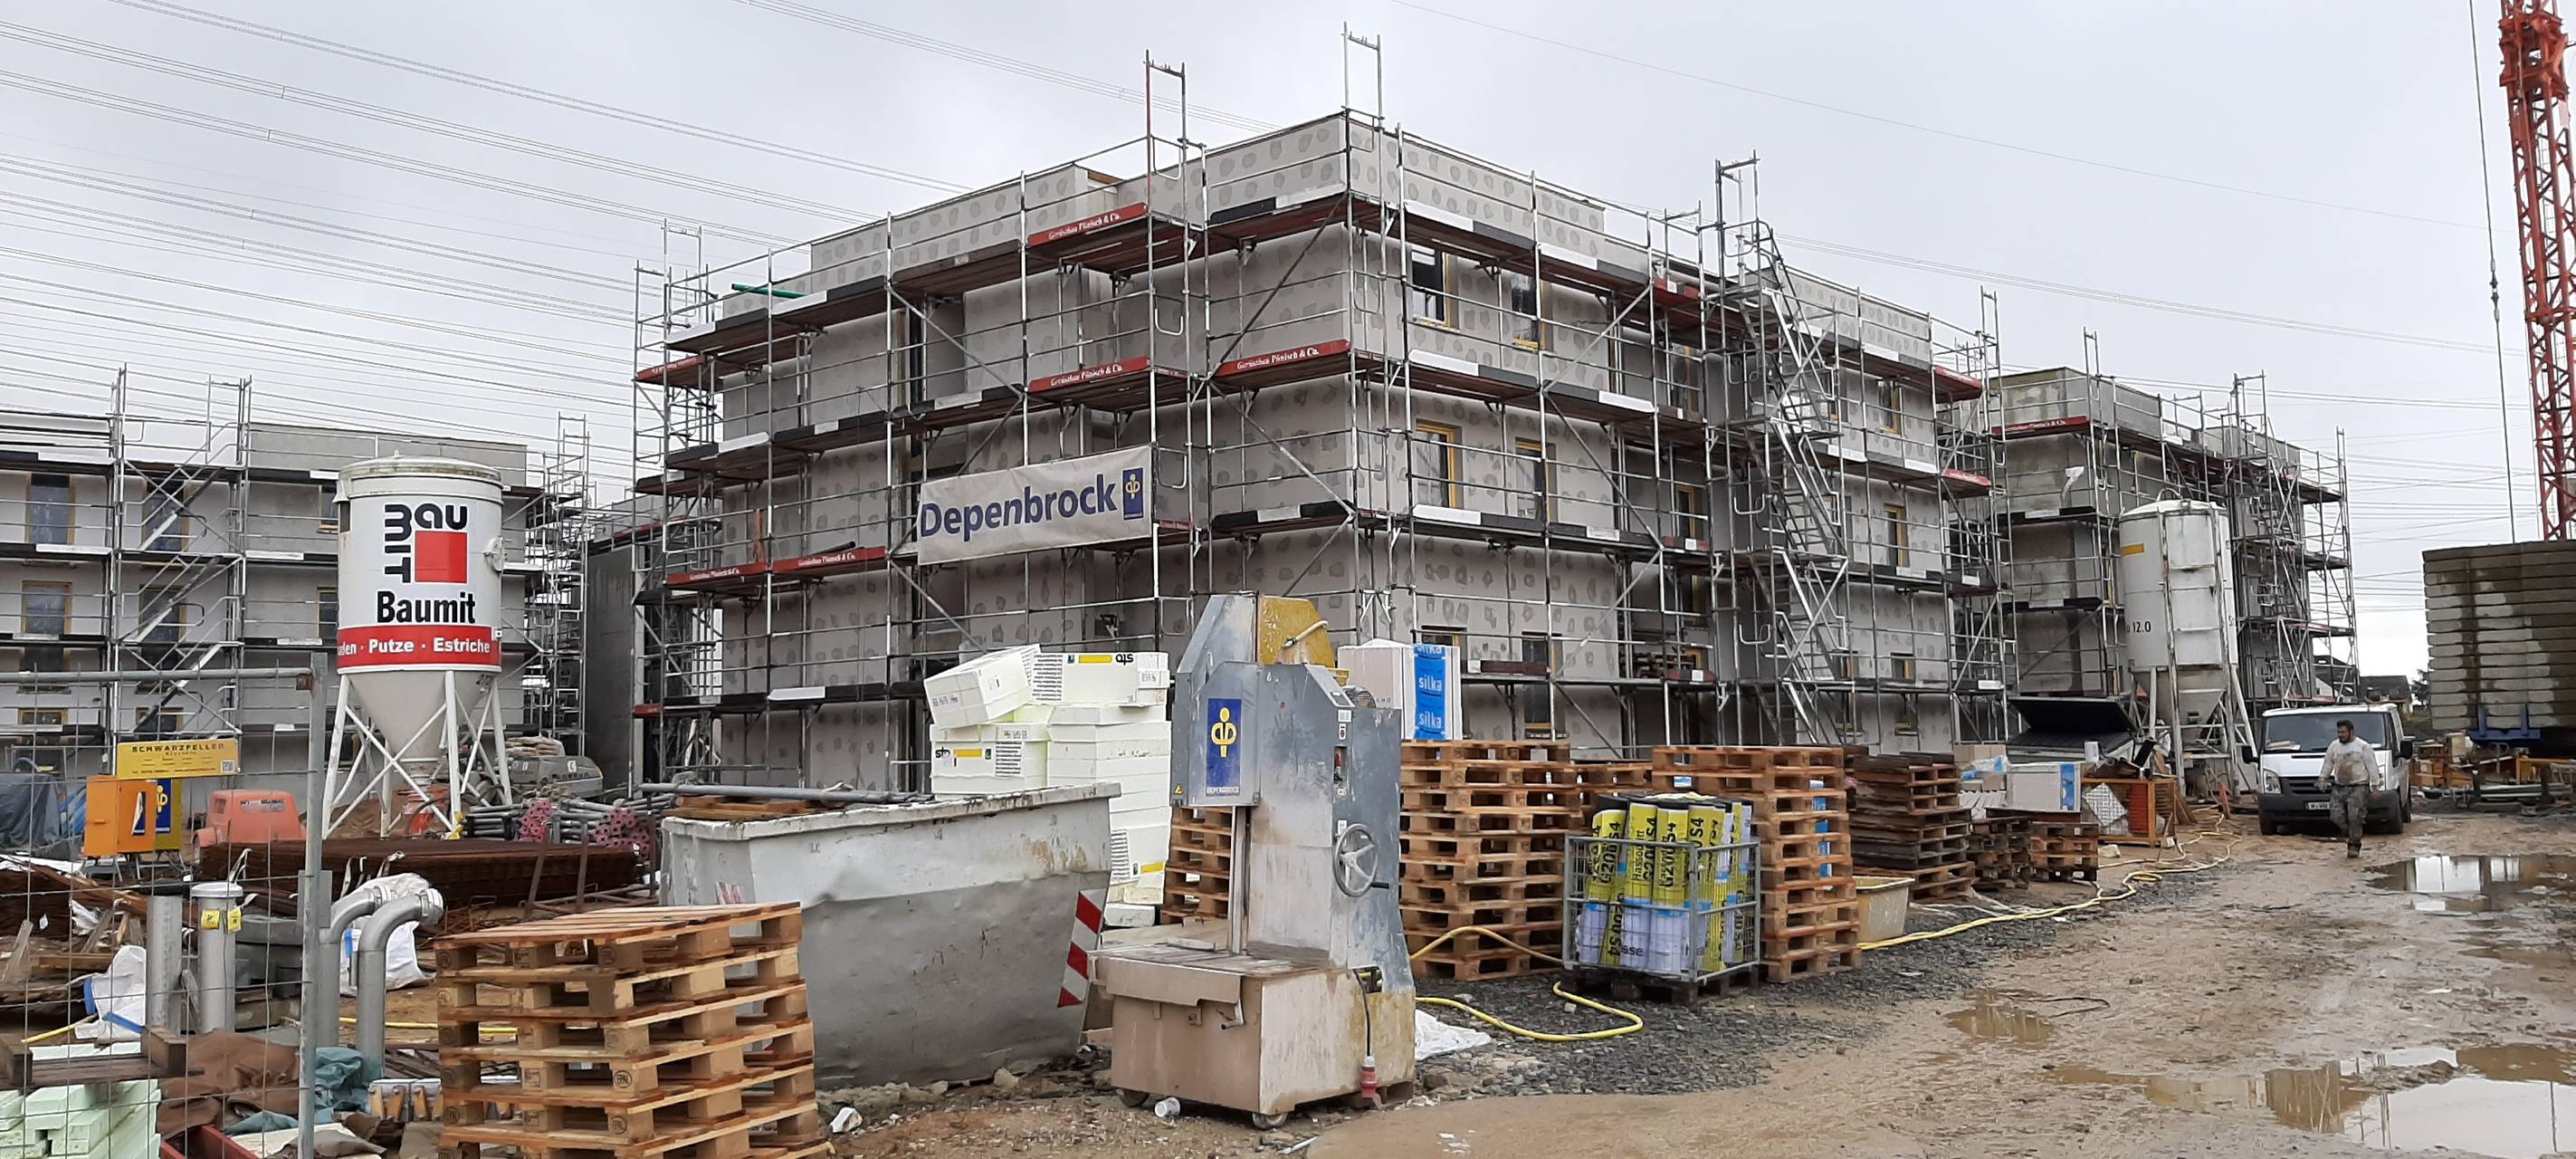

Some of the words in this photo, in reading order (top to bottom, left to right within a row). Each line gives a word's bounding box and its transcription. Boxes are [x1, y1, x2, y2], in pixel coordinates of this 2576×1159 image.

[1299, 350, 1305, 358] &
[920, 474, 1118, 542] Depenbrock
[377, 590, 475, 624] Baumit
[2132, 620, 2151, 633] 12.0
[368, 638, 415, 654] Putze
[434, 637, 491, 653] Estriche
[1115, 654, 1134, 666] sto
[1418, 675, 1442, 692] silka
[1418, 711, 1442, 729] silka
